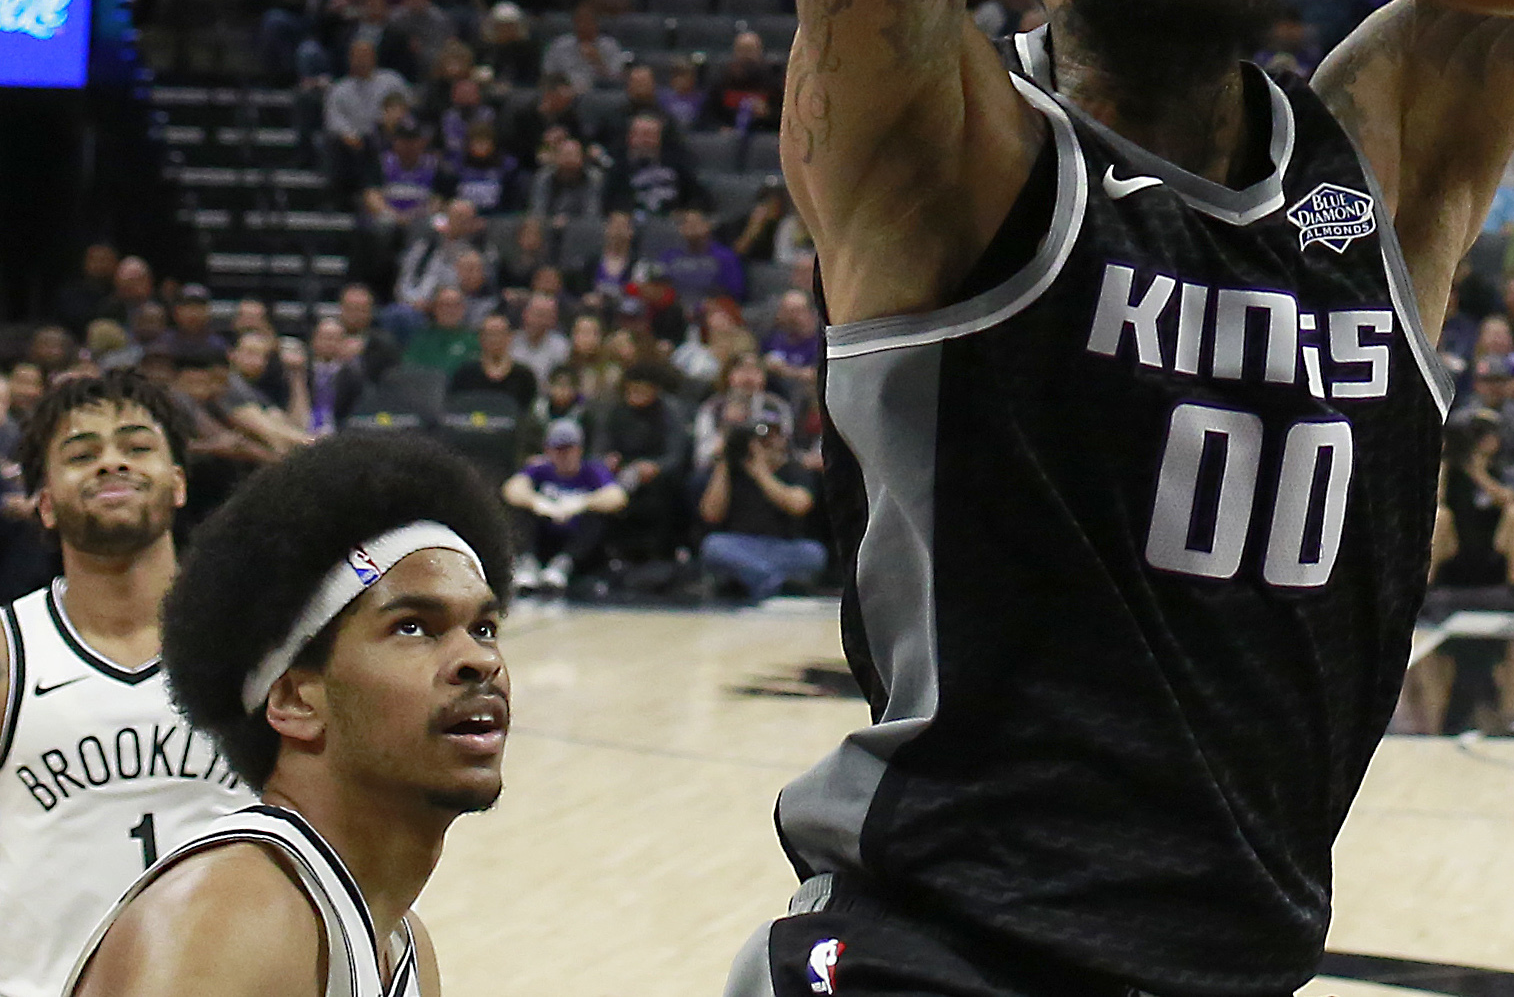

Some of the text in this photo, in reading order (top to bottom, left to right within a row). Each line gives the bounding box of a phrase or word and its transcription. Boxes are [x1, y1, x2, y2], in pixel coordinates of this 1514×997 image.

[1297, 200, 1368, 226] DIAMOND
[1312, 193, 1349, 211] BLUE
[1306, 222, 1370, 240] ALMONDS
[1145, 403, 1354, 587] 00
[129, 812, 158, 871] 1
